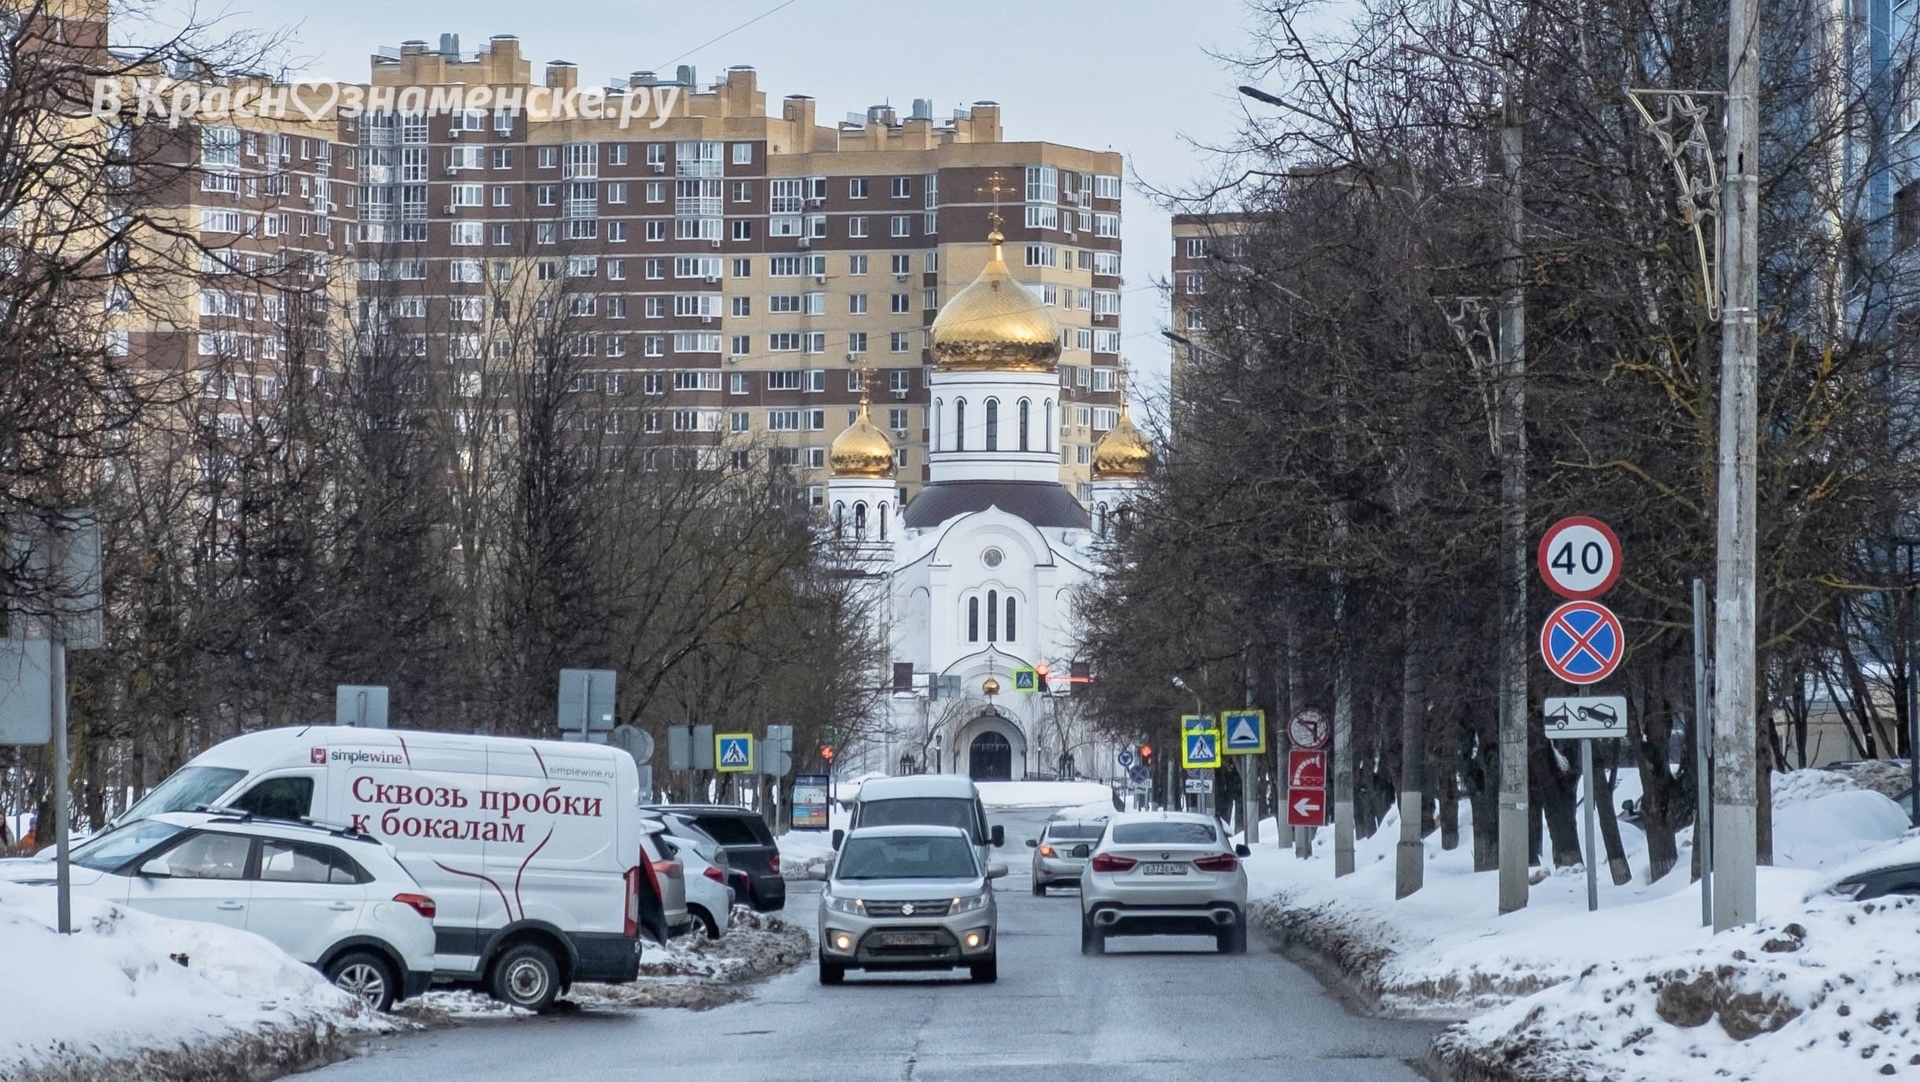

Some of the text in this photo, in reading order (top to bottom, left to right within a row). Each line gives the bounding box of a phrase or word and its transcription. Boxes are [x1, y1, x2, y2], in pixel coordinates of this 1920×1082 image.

[1551, 541, 1604, 575] 40
[331, 749, 403, 764] simplewine
[549, 766, 614, 779] simplewine.ru
[352, 776, 603, 819] Сквозь пробки
[351, 807, 526, 843] к бокалам
